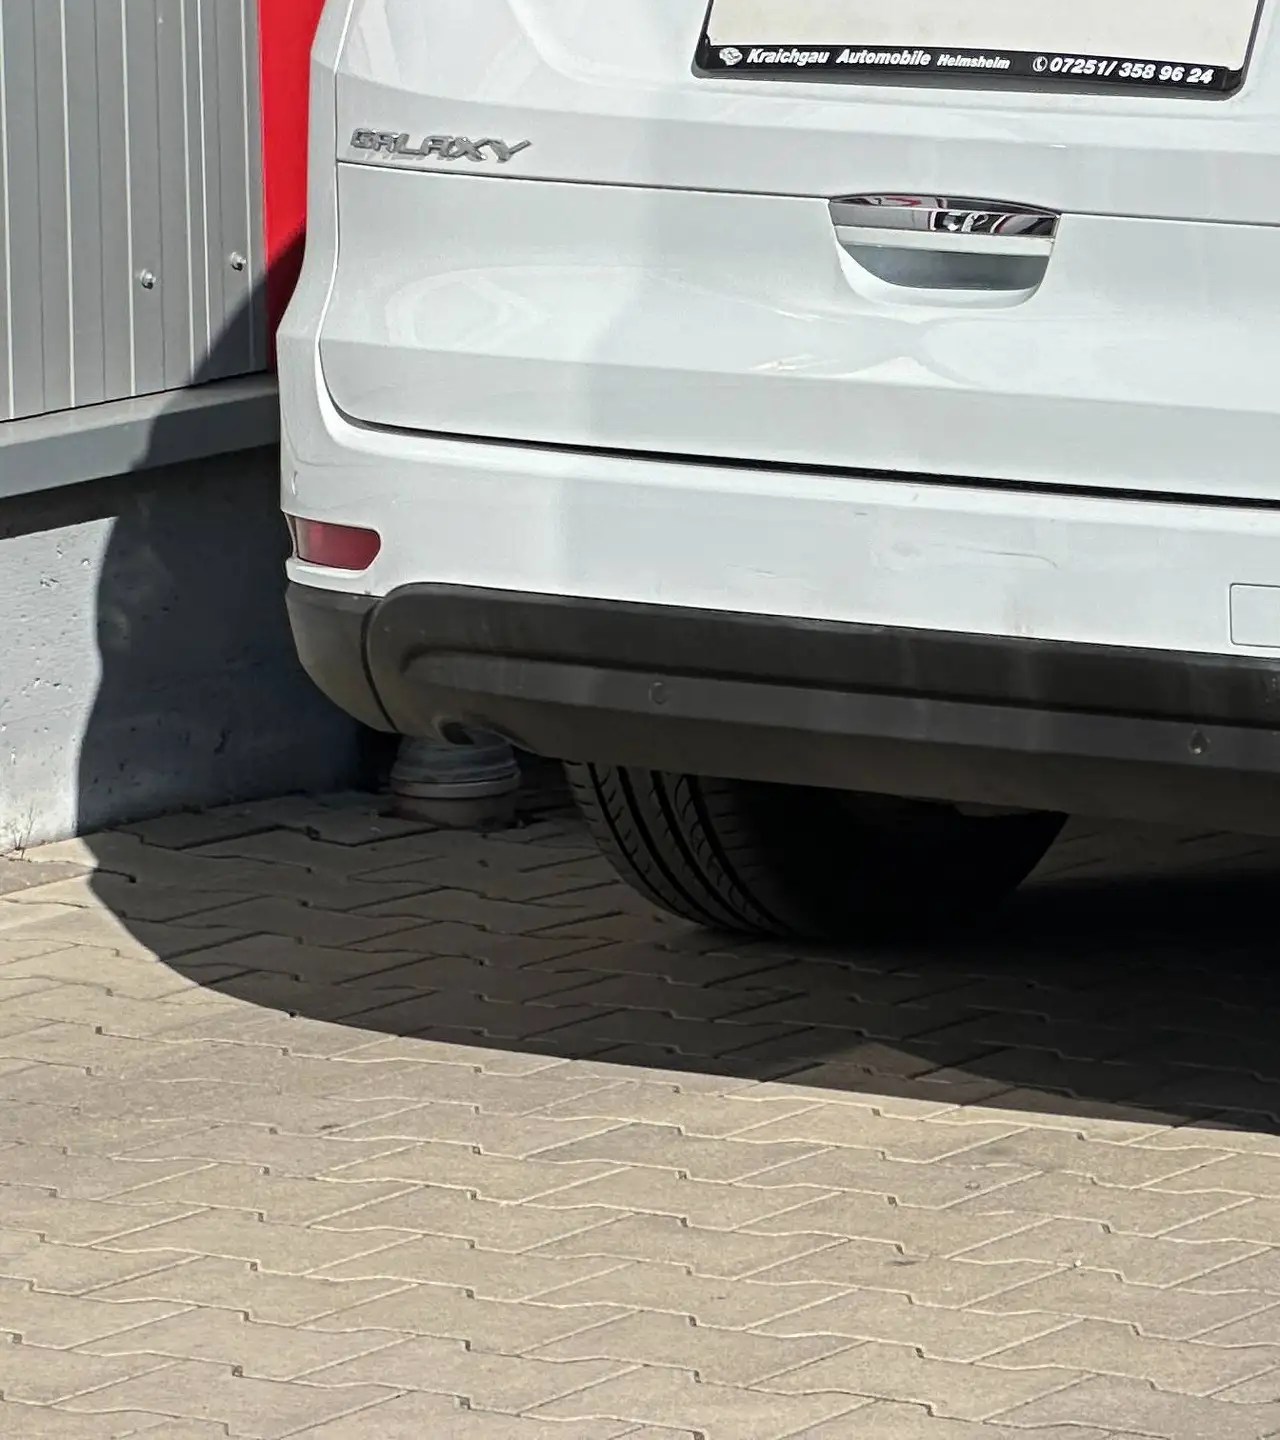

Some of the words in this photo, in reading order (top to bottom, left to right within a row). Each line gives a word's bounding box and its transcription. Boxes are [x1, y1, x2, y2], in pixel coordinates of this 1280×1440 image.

[747, 48, 830, 67] Kraichgau
[836, 48, 932, 65] Automobile
[937, 53, 1010, 70] Helmsheim
[1118, 61, 1155, 79] 358
[1157, 65, 1185, 82] 96
[1185, 66, 1214, 84] 24
[350, 127, 533, 163] GALAXY
